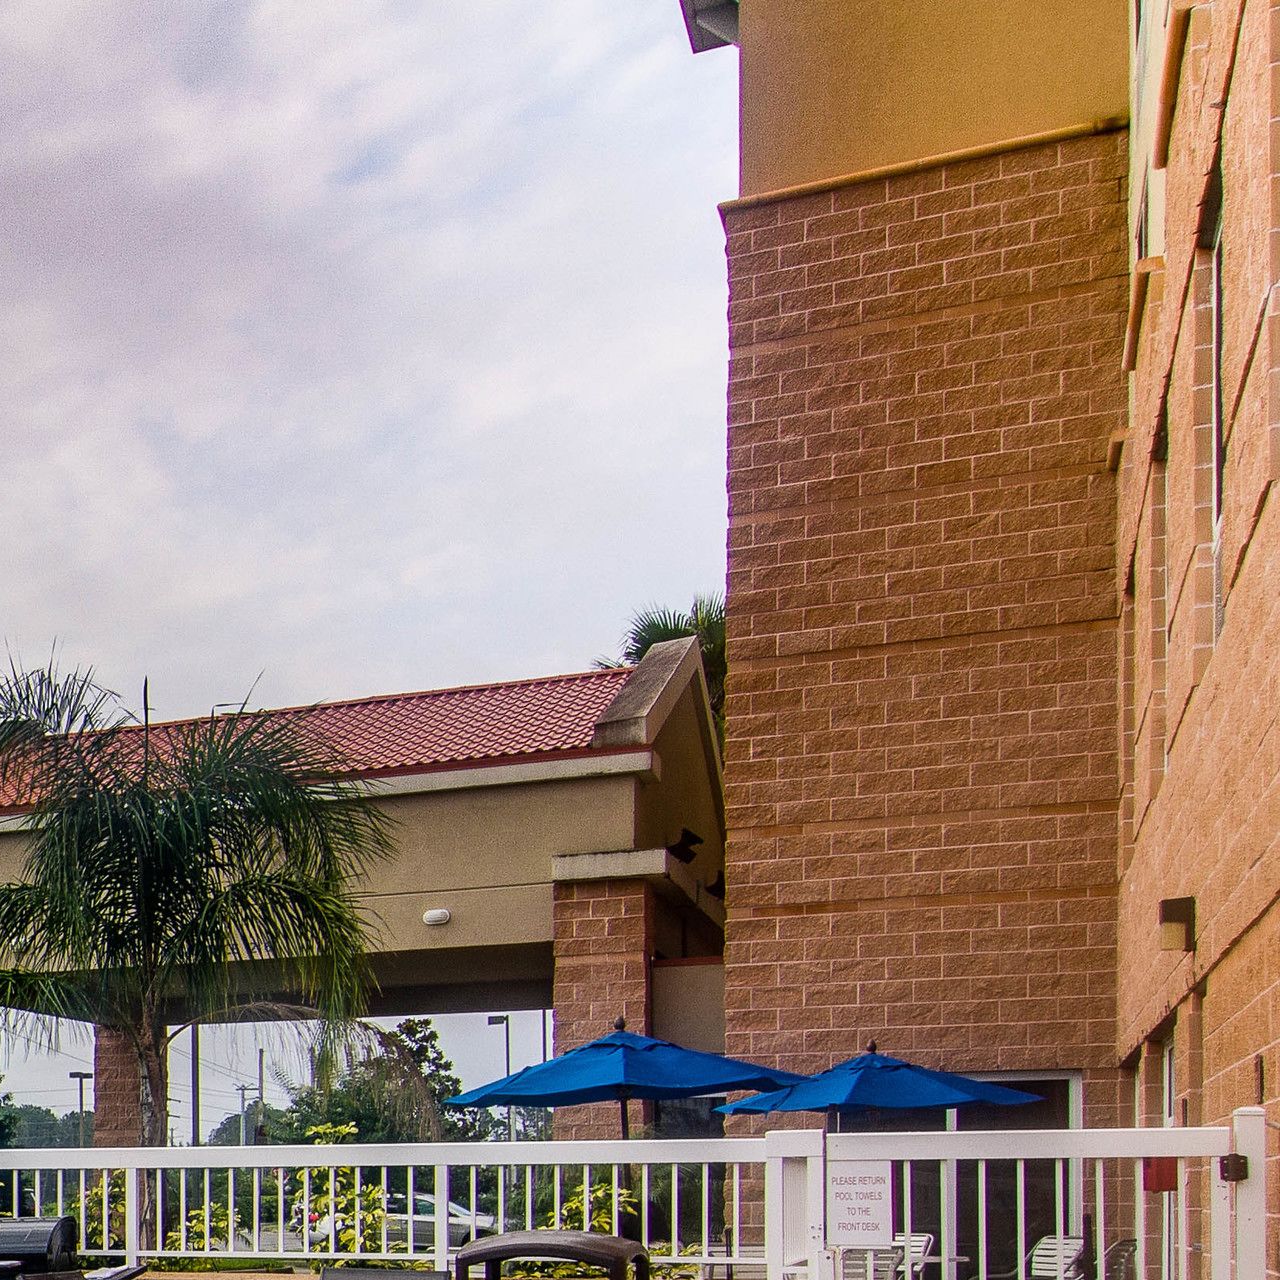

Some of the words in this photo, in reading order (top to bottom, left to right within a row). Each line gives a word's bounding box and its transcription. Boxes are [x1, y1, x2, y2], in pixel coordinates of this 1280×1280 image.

[831, 1176, 857, 1186] PLEASE
[859, 1176, 886, 1185] RETURN
[835, 1192, 853, 1200] POOL
[855, 1192, 882, 1201] TOWELS
[847, 1207, 856, 1216] TO
[858, 1207, 871, 1216] THE
[838, 1223, 860, 1231] FRONT
[862, 1222, 880, 1232] DESK
